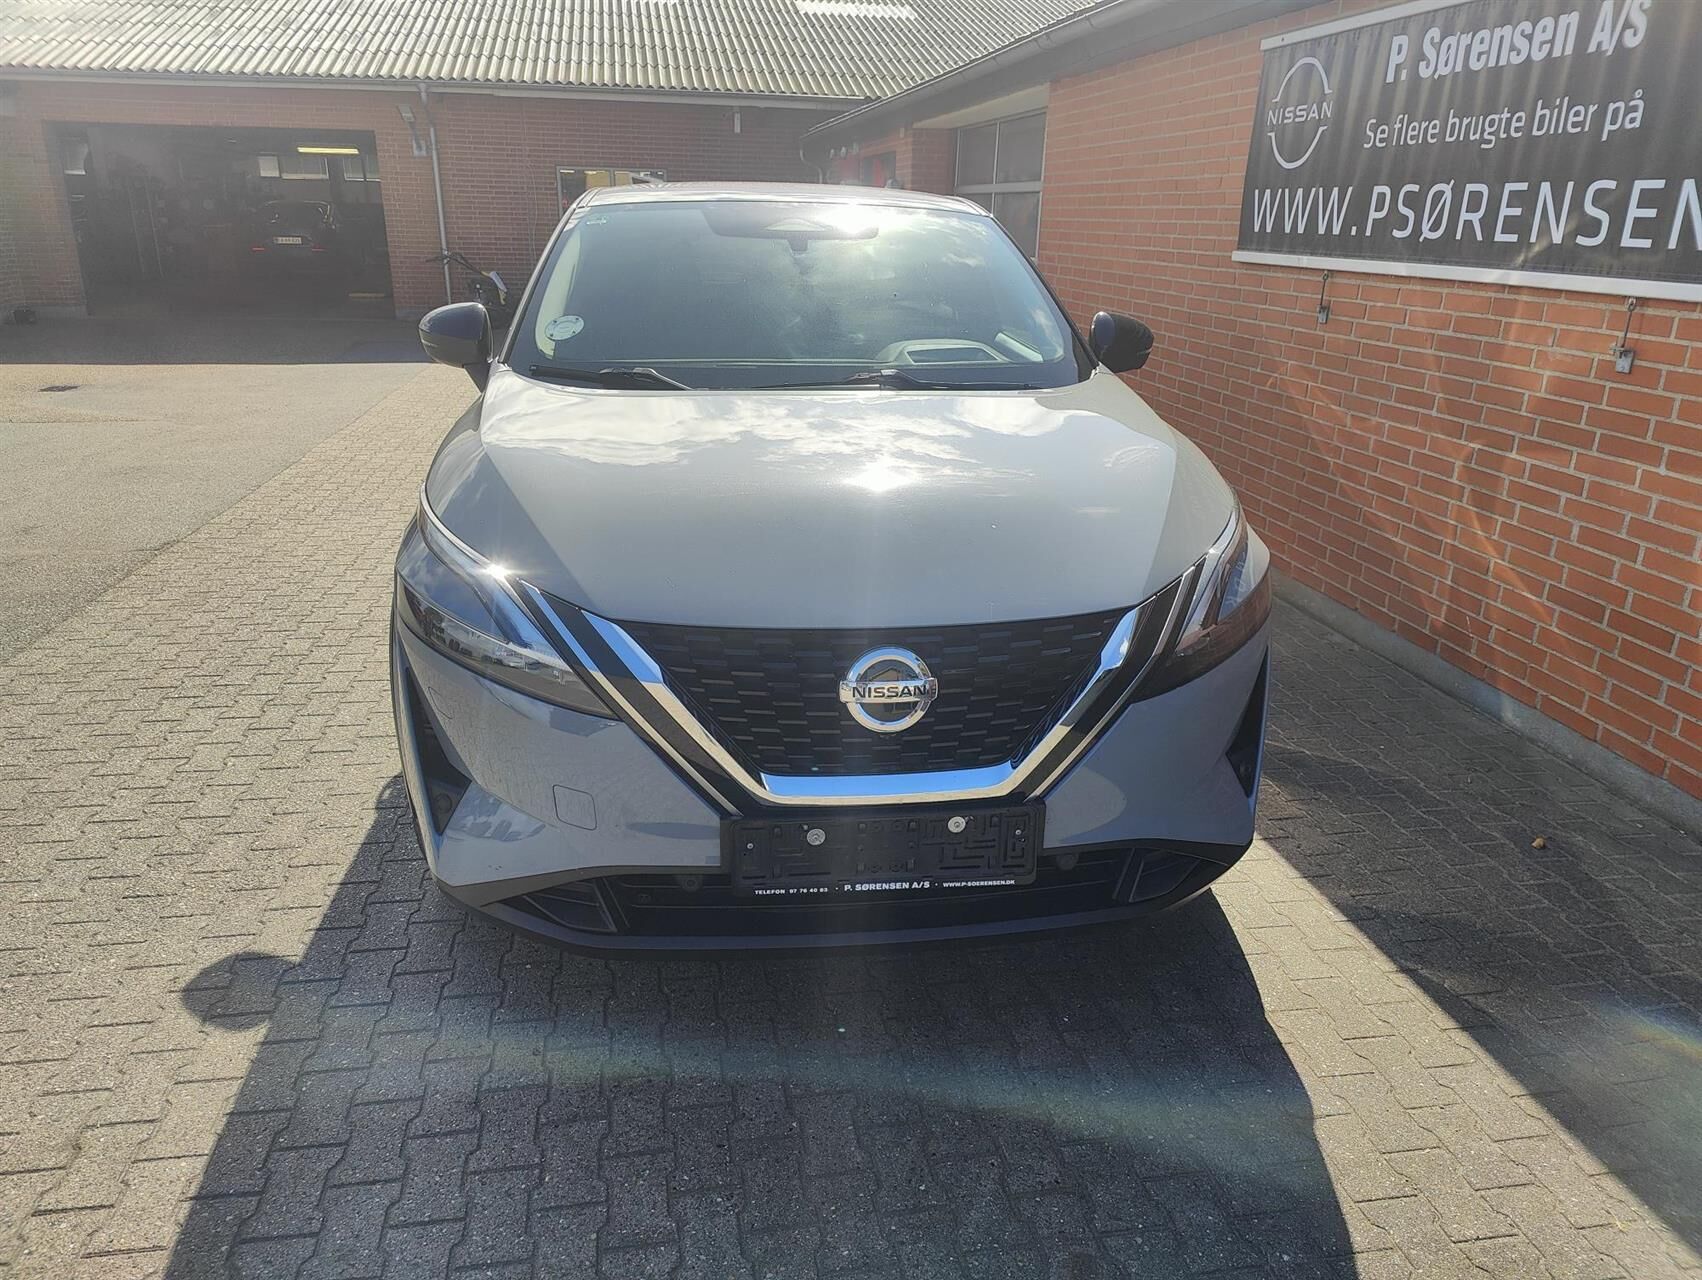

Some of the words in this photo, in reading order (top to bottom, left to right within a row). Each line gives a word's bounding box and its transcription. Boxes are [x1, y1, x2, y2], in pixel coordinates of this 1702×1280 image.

[1385, 34, 1409, 84] P.
[1418, 10, 1580, 80] Sørensen
[1587, 0, 1651, 57] A/S
[1267, 101, 1333, 126] NISSAN
[1363, 118, 1388, 149] Se
[1392, 113, 1441, 147] flere
[1445, 107, 1526, 149] brugte
[1532, 96, 1600, 137] biler
[1601, 88, 1645, 142] på
[852, 685, 927, 699] NISSAN
[754, 888, 786, 896] TELEFON
[844, 884, 853, 892] P.
[855, 881, 910, 891] SØRENSEN
[911, 881, 931, 889] A/S
